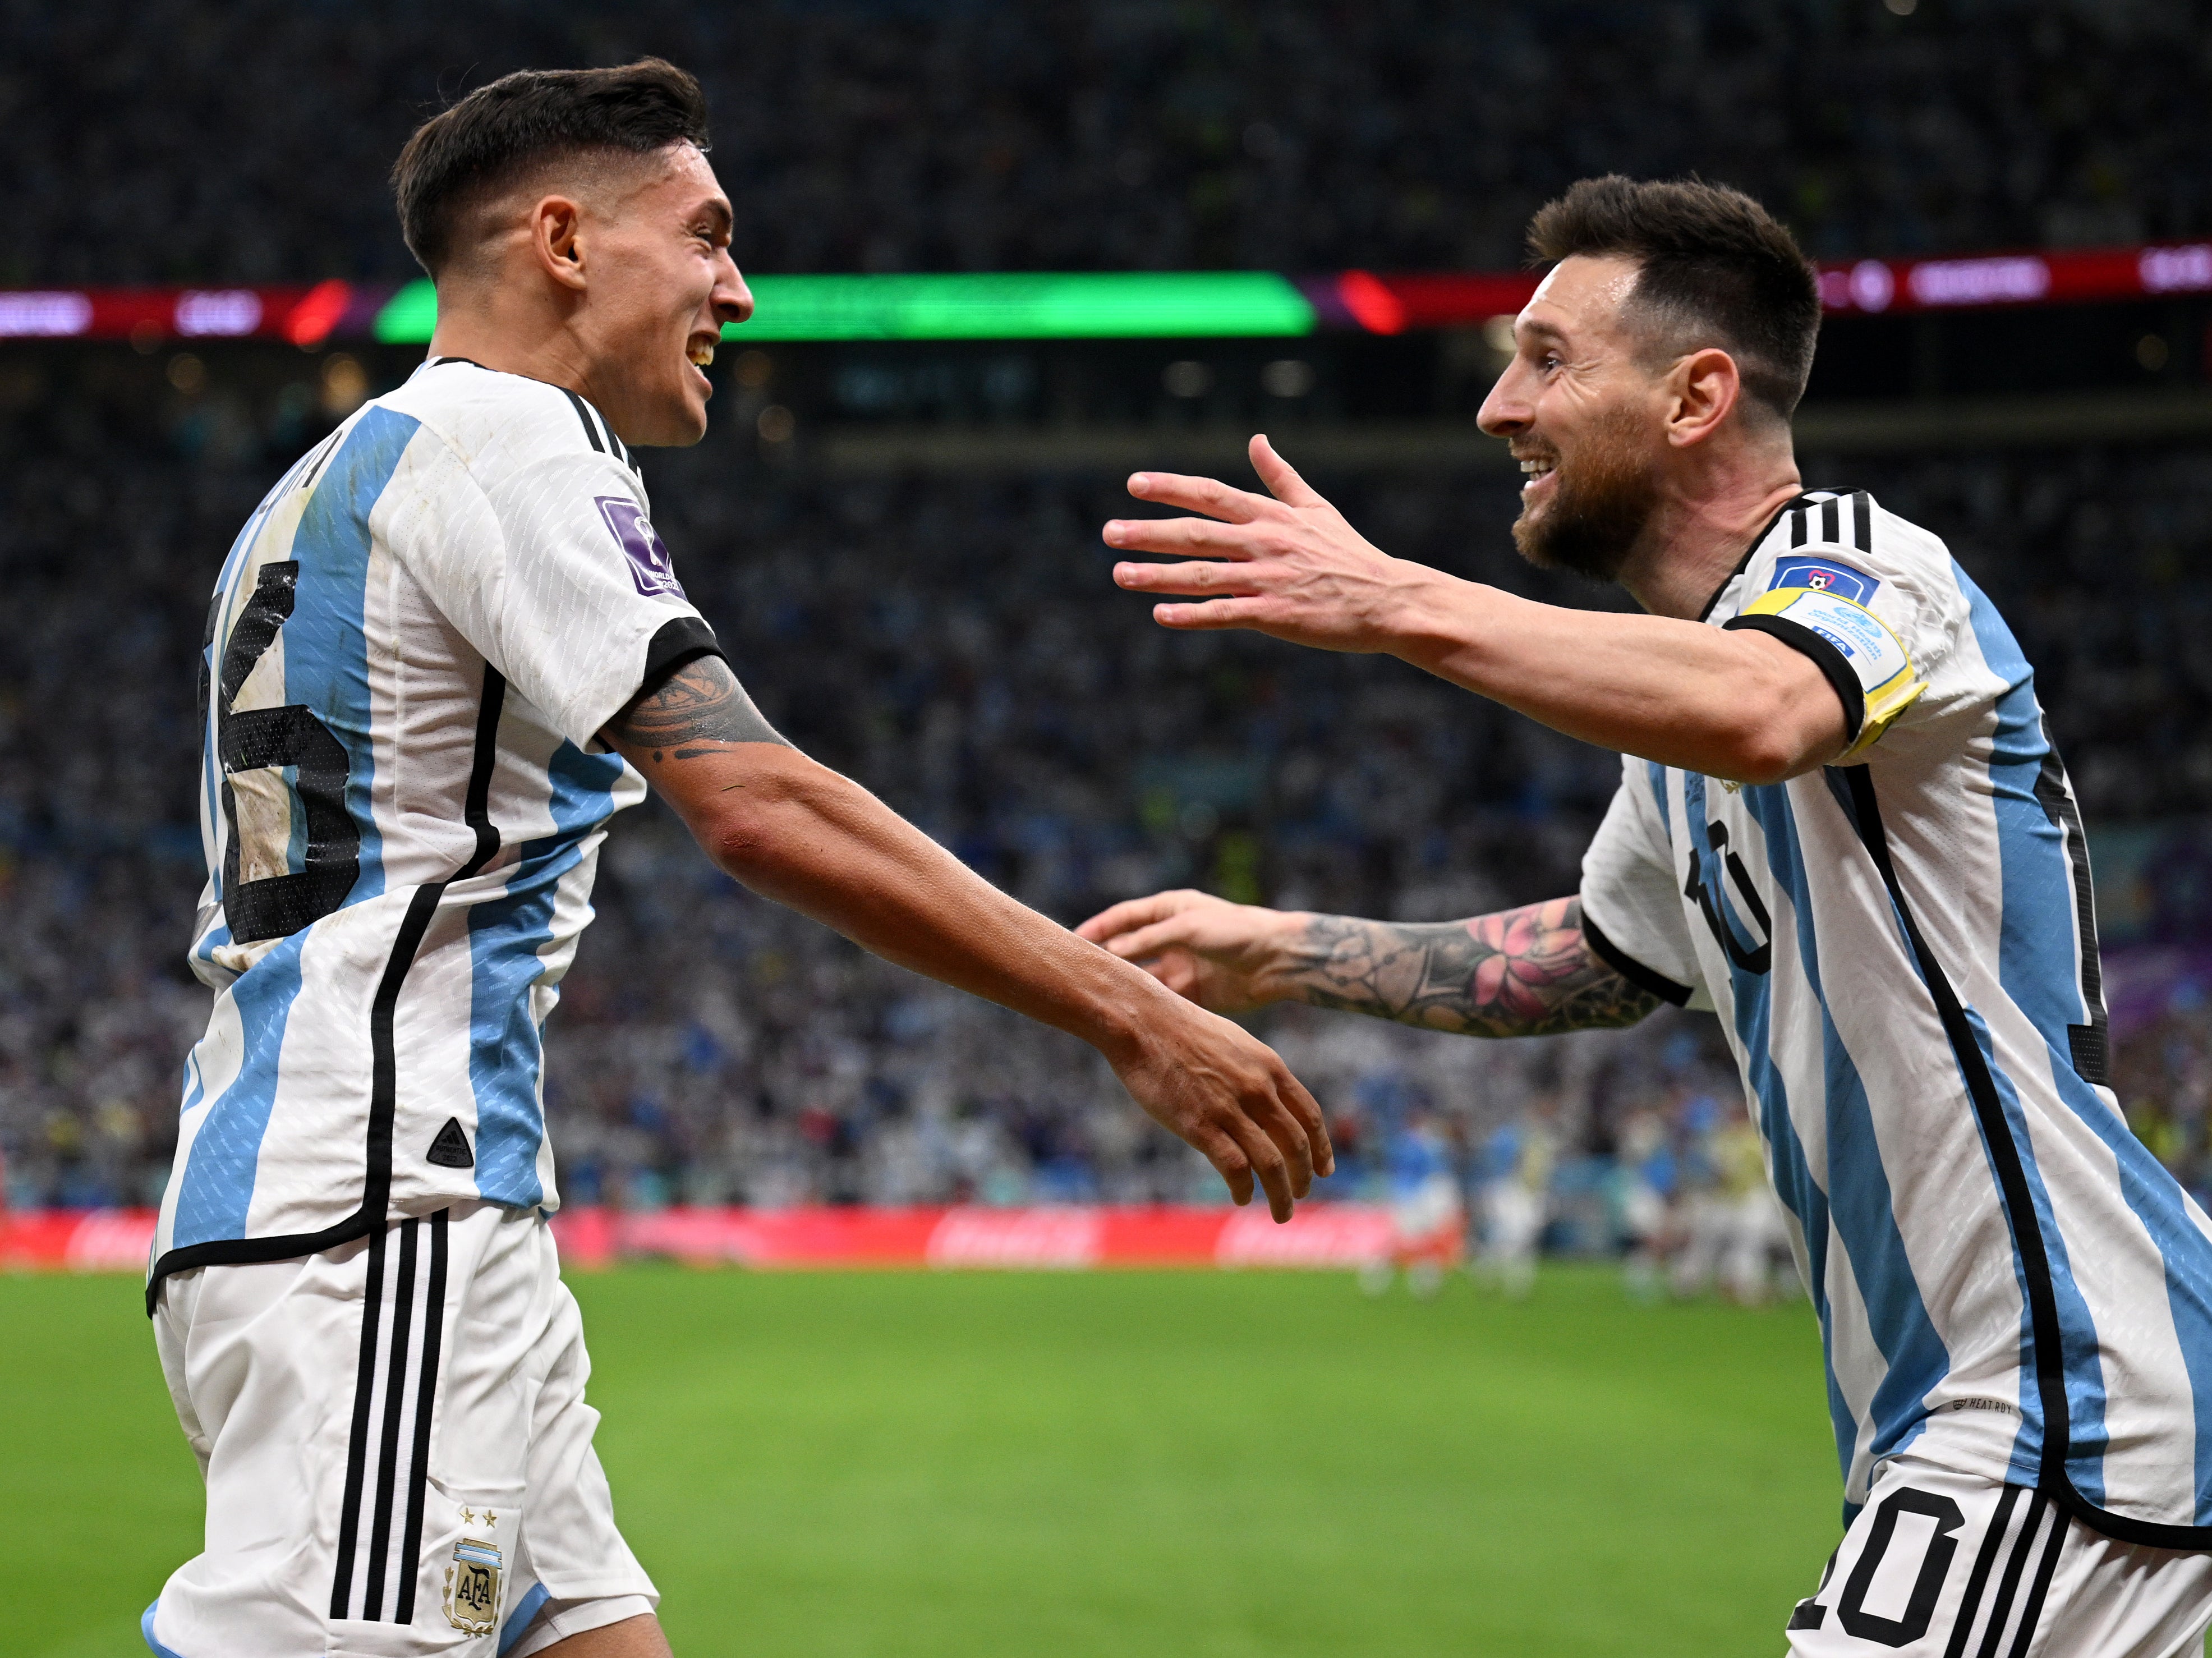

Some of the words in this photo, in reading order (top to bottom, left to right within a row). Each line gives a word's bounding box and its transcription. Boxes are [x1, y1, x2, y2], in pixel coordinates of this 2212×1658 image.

[1808, 612, 1878, 660] Organization
[1813, 609, 1848, 624] World
[1851, 626, 1882, 657] Health
[1816, 629, 1847, 652] FIFA
